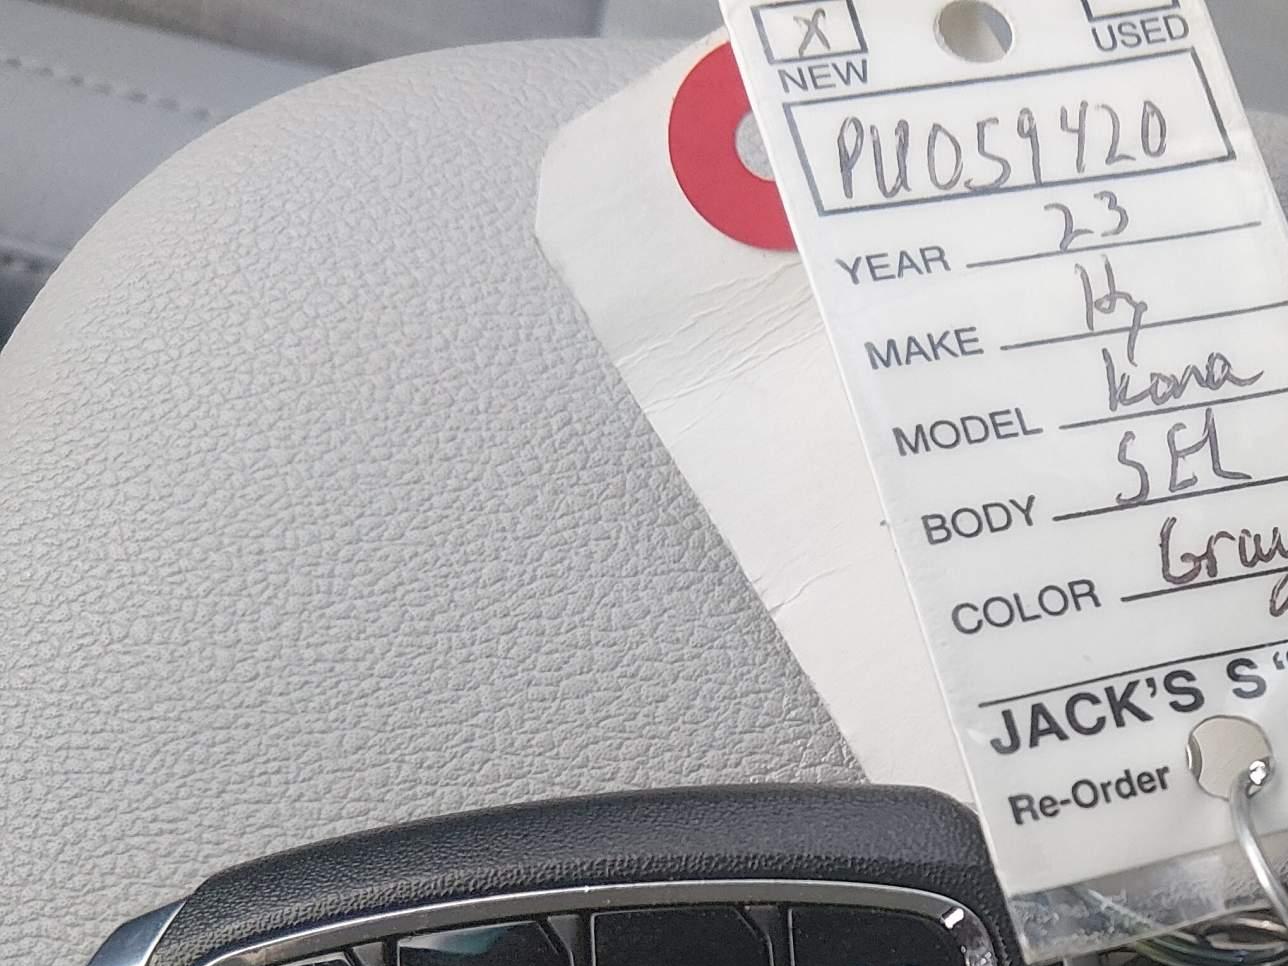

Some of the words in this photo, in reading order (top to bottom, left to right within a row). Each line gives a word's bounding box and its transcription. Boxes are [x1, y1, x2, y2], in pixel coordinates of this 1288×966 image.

[1090, 13, 1190, 52] USED
[777, 59, 868, 94] NEW
[837, 99, 1168, 199] PU059420
[1044, 191, 1129, 252] 23
[836, 246, 951, 285] YEAR
[865, 327, 984, 370] MAKE
[892, 406, 1043, 457] MODEL
[1116, 405, 1252, 505] SEL
[921, 494, 1037, 545] BODY
[951, 578, 1101, 636] COLOR
[989, 668, 1205, 755] JACK’S
[1226, 658, 1267, 701] S
[1007, 765, 1170, 825] Re-Order
